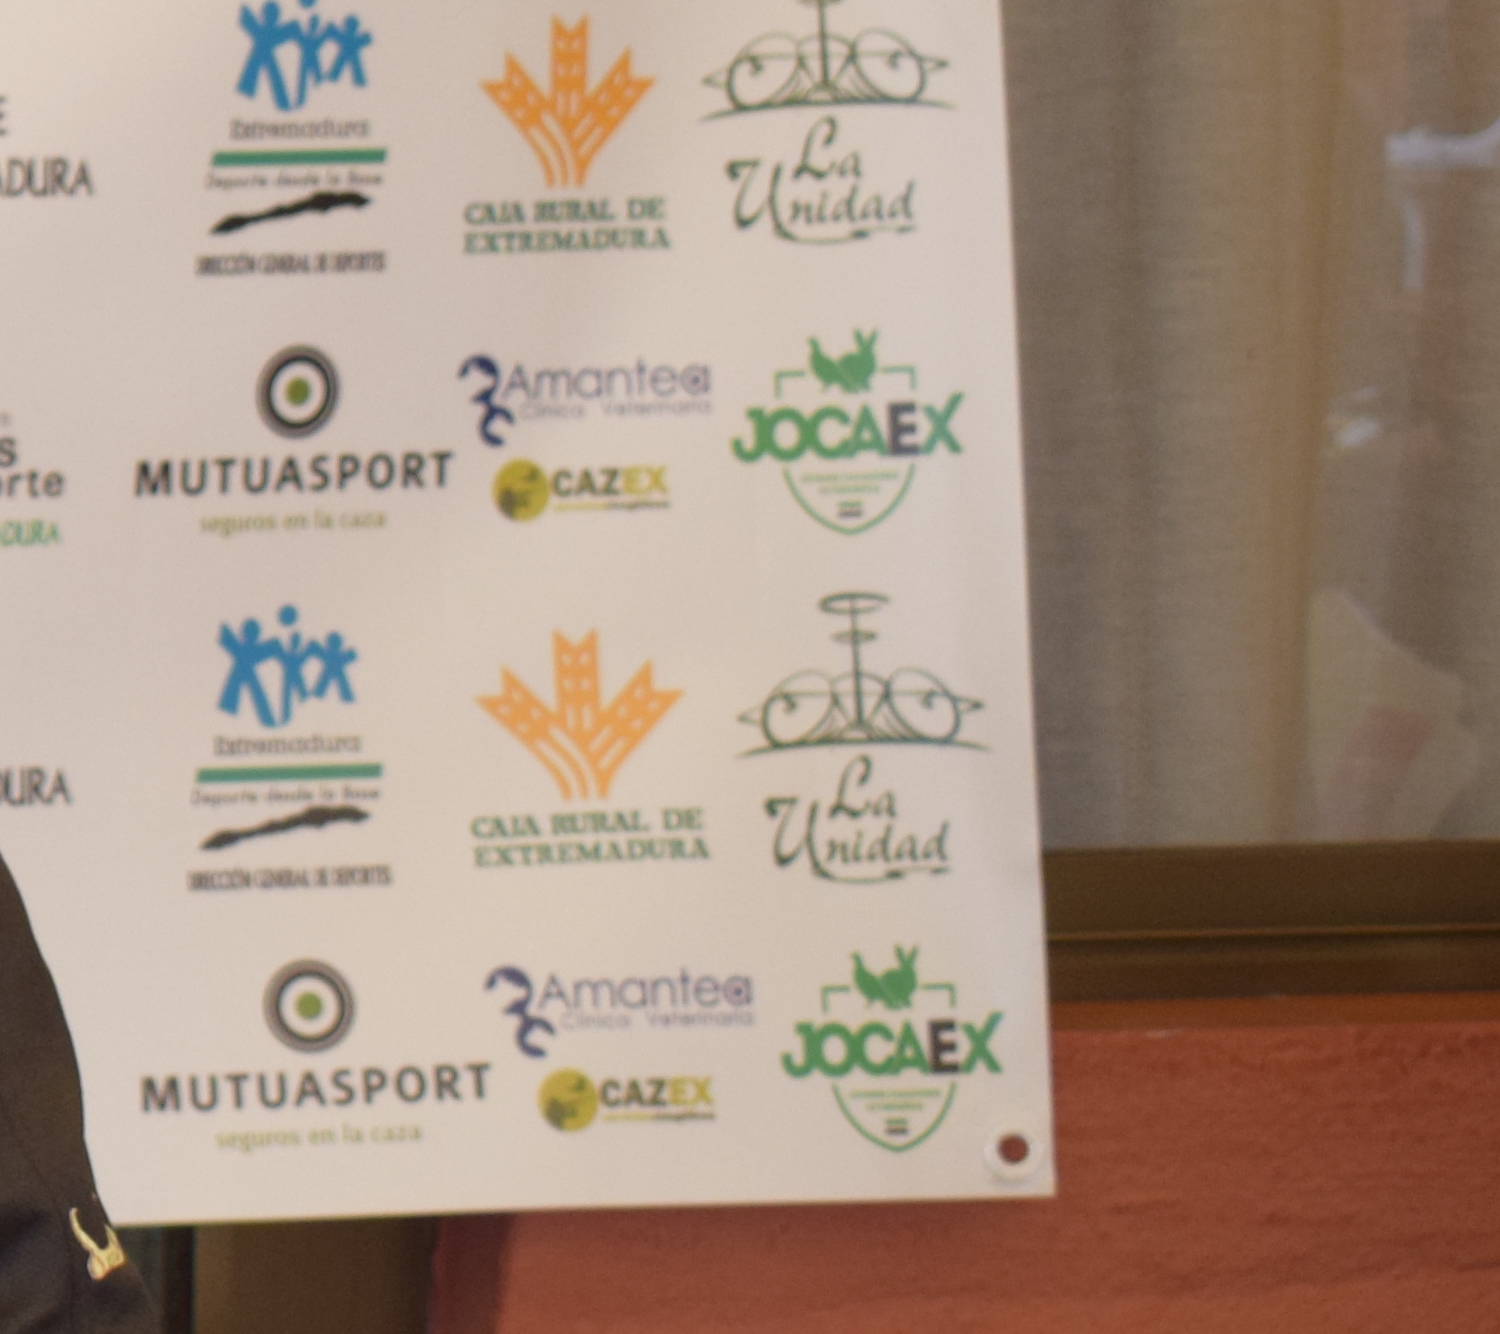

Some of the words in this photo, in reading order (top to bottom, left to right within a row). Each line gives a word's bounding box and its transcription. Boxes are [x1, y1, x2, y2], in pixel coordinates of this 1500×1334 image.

[230, 118, 370, 142] Extremadura
[792, 115, 863, 180] La
[464, 201, 527, 226] CAJA
[533, 199, 615, 224] RURAL
[627, 197, 666, 220] DE
[724, 158, 917, 245] Unidad
[463, 227, 672, 256] EXTREMADURA
[729, 392, 965, 464] JOCAEX
[133, 450, 456, 498] MUTUASPORT
[551, 464, 672, 498] CAZEX
[199, 512, 277, 539] seguros
[283, 514, 308, 530] en
[312, 508, 334, 528] la
[338, 512, 387, 529] caza
[213, 735, 362, 757] Extremadura
[829, 753, 896, 819] La
[470, 815, 541, 840] CAJA
[552, 811, 648, 836] RURAL
[662, 808, 706, 831] DE
[474, 837, 710, 868] EXTREMADURA
[765, 796, 953, 886] Unidad
[780, 1011, 1004, 1078] JOCAEX
[139, 1062, 493, 1113] MUTUASPORT
[600, 1076, 714, 1108] CAZEX
[214, 1128, 300, 1153] seguros
[307, 1127, 336, 1145] en
[342, 1123, 363, 1144] la
[370, 1124, 422, 1142] caza
